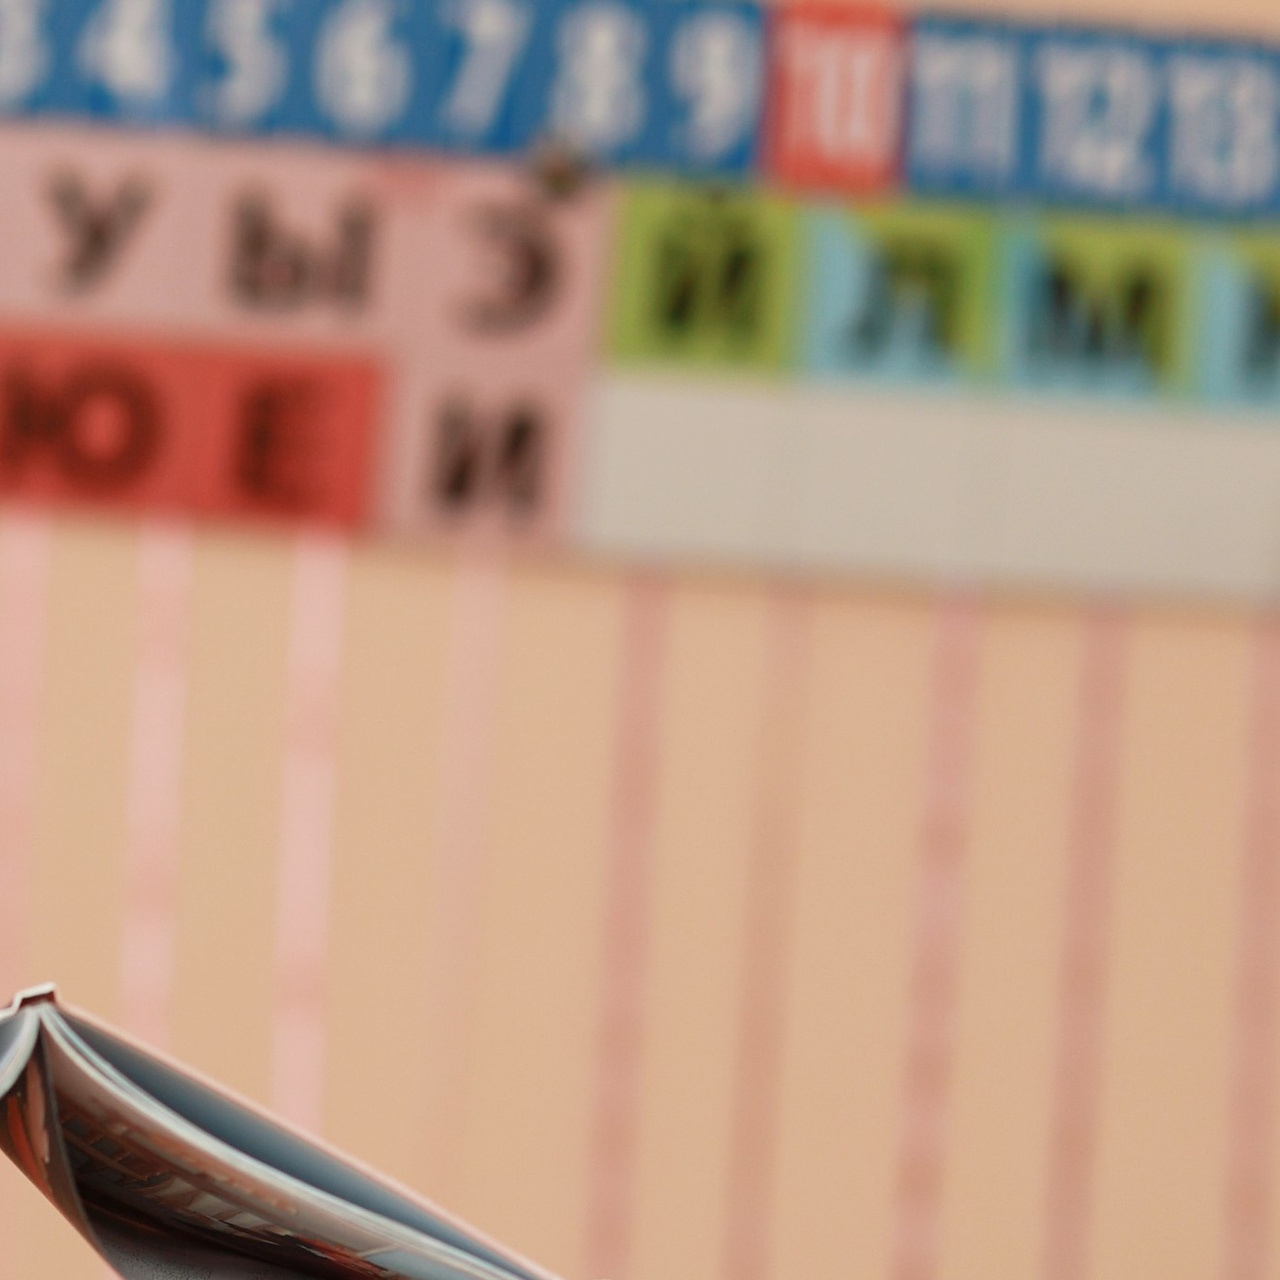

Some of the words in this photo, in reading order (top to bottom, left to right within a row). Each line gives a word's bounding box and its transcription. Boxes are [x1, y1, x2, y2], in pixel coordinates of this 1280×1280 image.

[78, 0, 174, 110] 4
[198, 0, 290, 126] 5
[316, 0, 408, 134] 6
[436, 0, 530, 138] 7
[548, 4, 652, 152] 8
[666, 6, 758, 158] 9
[788, 22, 900, 166] 10
[916, 34, 1016, 166] 11
[1032, 40, 1154, 196] 12
[1168, 52, 1278, 200] 13
[42, 168, 158, 300] У
[222, 188, 387, 322] Ы
[454, 196, 562, 338] Э
[1023, 250, 1174, 376] М
[425, 394, 553, 526] И
